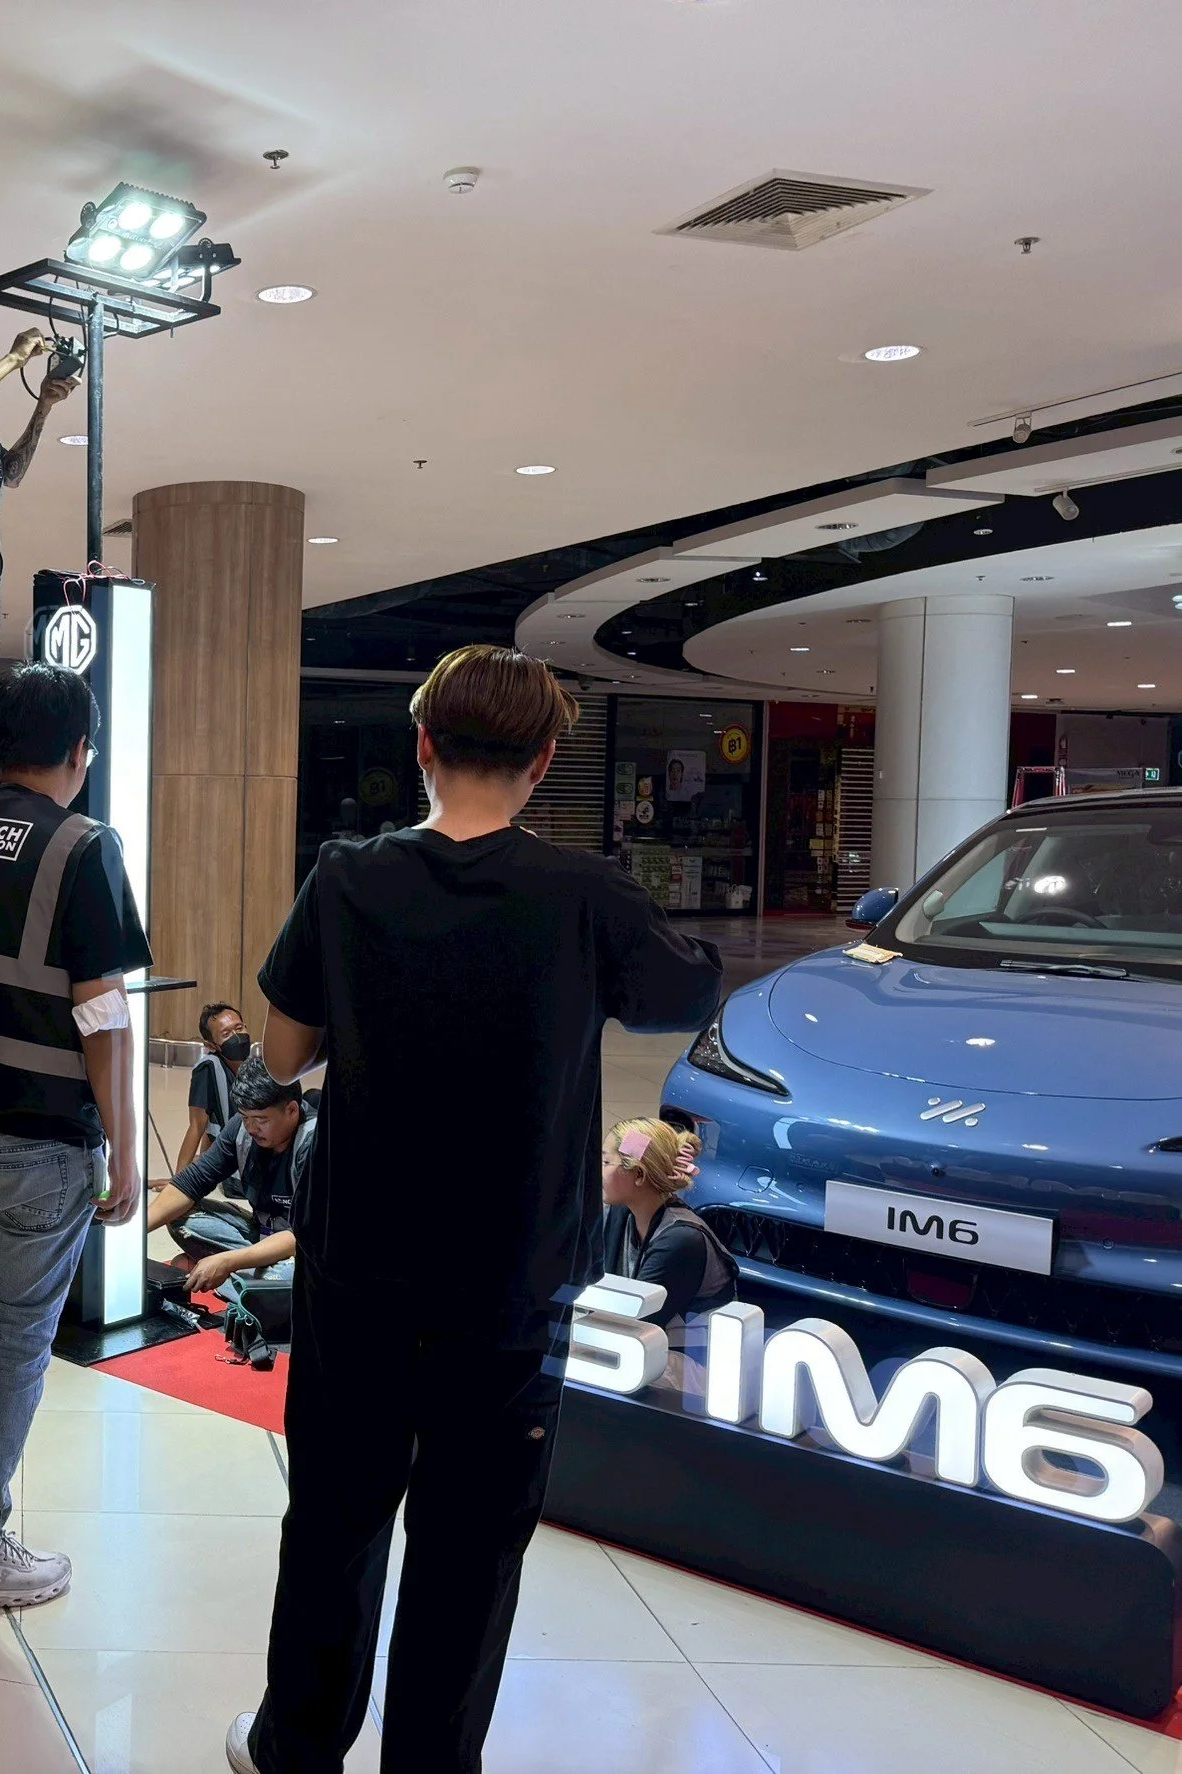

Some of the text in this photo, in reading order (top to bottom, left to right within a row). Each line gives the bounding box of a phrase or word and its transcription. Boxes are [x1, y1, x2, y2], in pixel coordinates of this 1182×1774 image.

[50, 611, 91, 668] MG
[886, 1206, 978, 1245] IM6
[705, 1301, 1166, 1523] IM6
